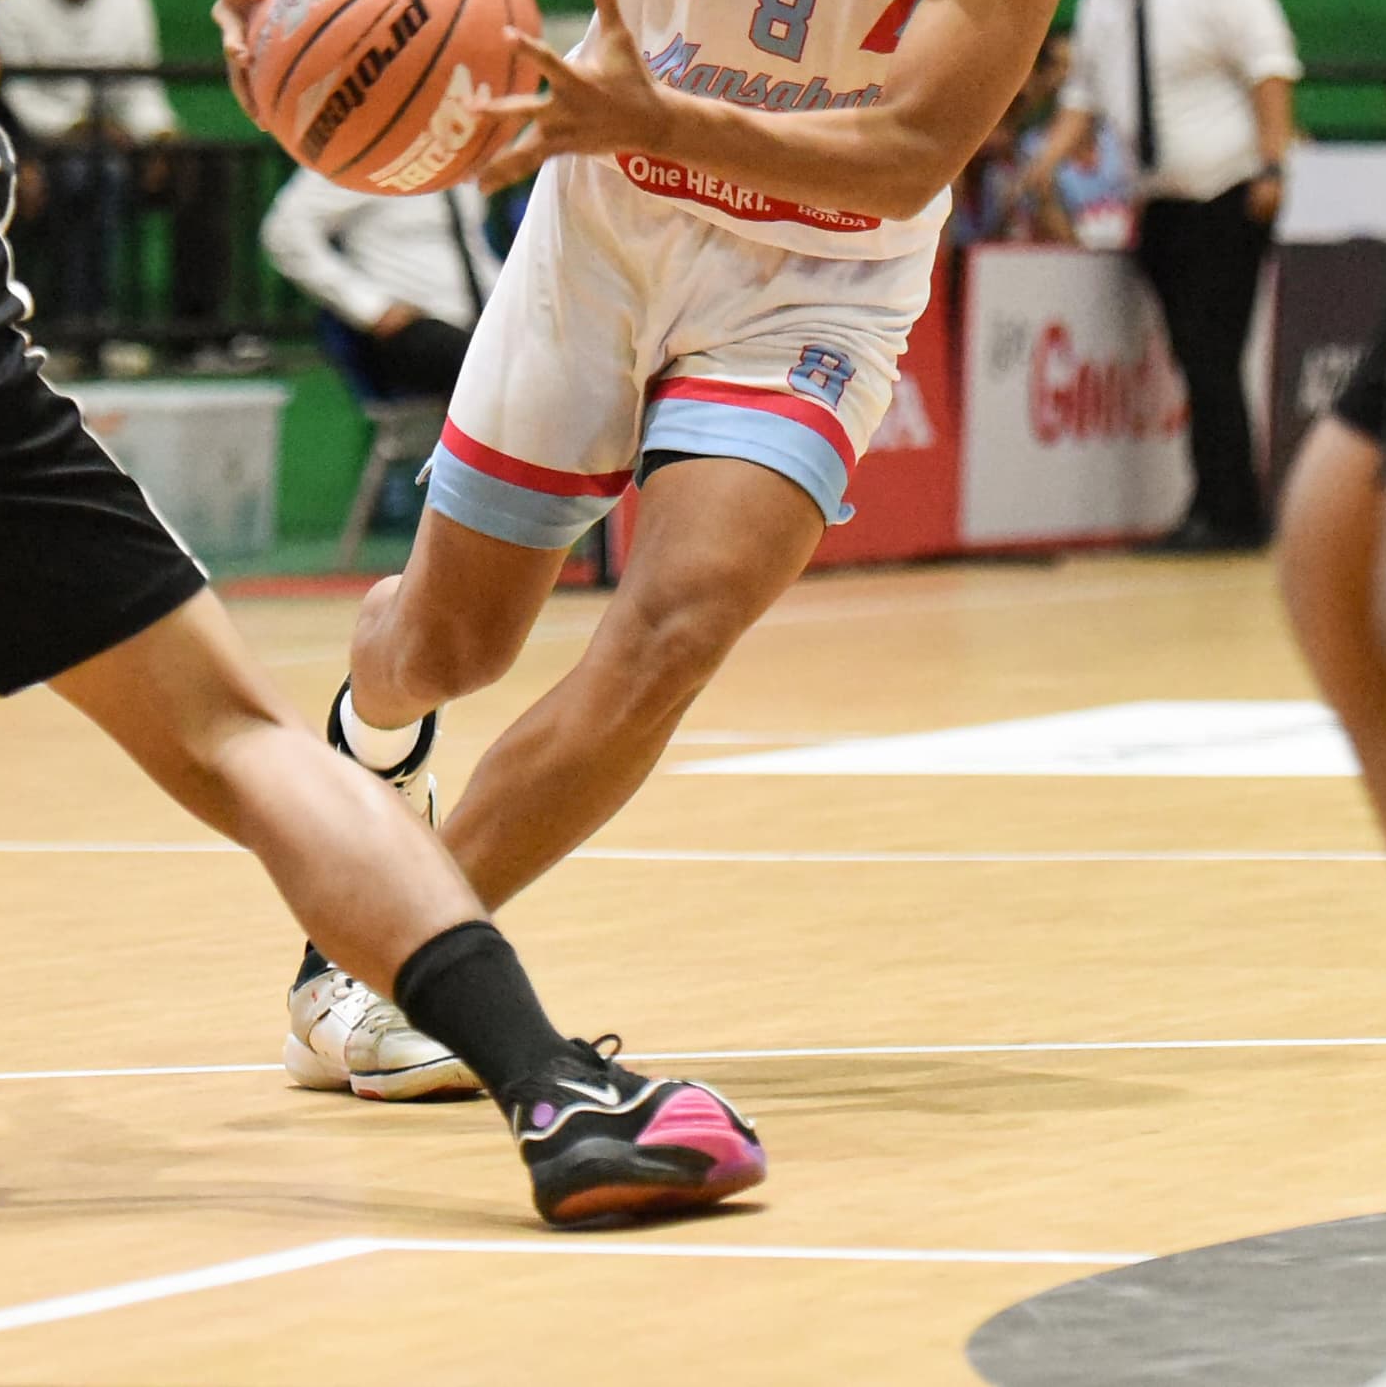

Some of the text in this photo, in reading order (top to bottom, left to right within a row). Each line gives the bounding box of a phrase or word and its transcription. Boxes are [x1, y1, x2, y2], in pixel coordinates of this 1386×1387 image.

[628, 156, 681, 186] One
[798, 204, 867, 228] HONDA
[787, 343, 857, 411] 8
